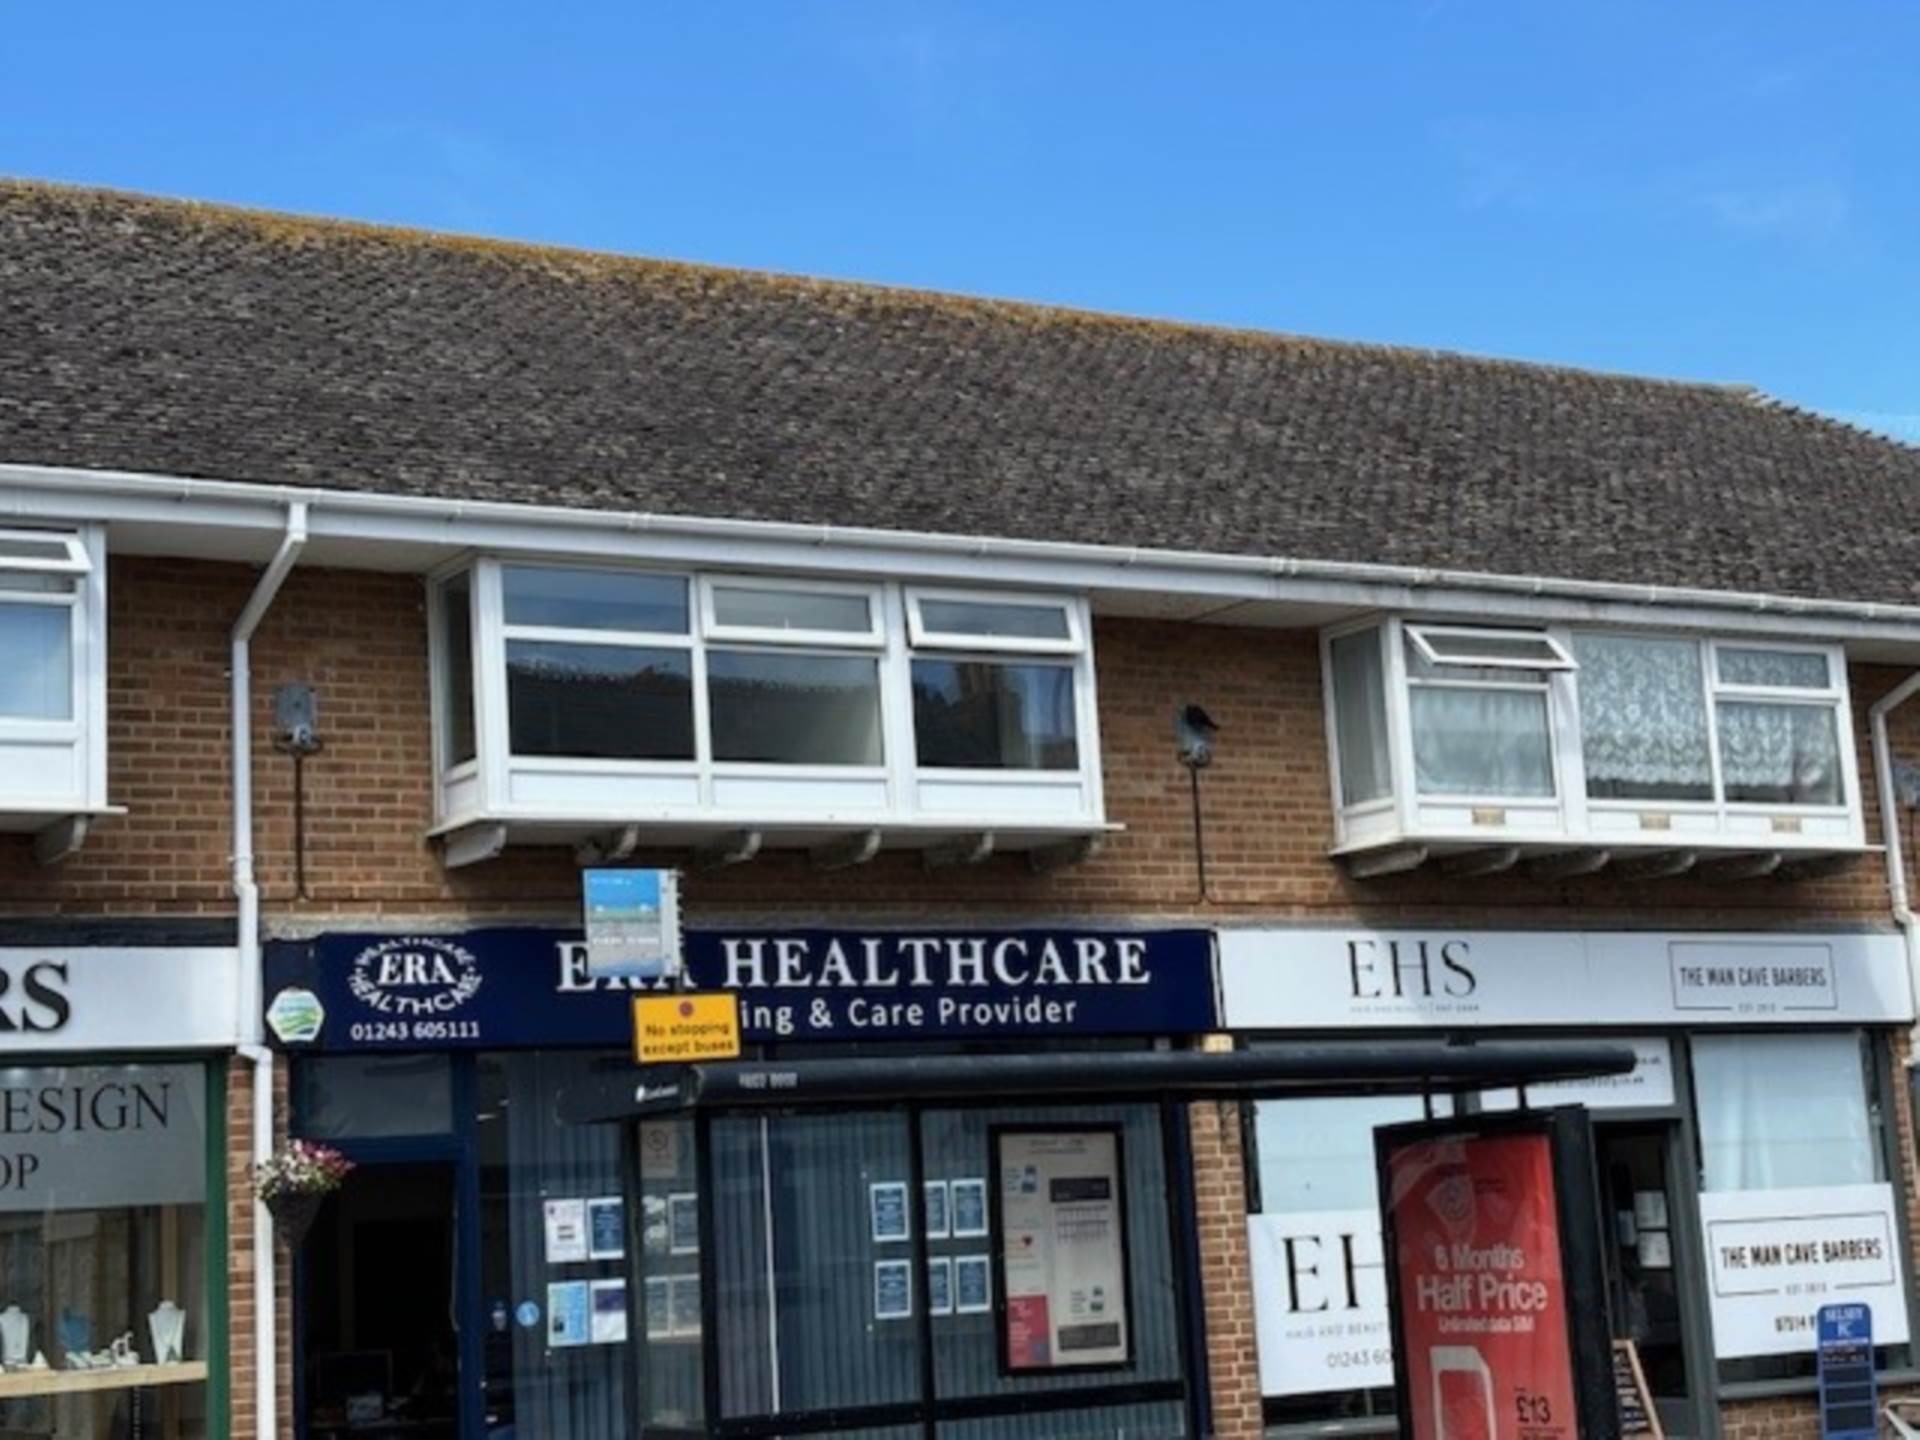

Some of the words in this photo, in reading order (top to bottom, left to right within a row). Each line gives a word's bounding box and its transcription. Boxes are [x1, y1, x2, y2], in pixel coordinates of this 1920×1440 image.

[377, 952, 456, 984] ERA
[722, 937, 1151, 988] HEALTHCARE
[1347, 940, 1477, 998] EHS
[1680, 967, 1704, 986] THE
[1706, 967, 1735, 986] MAN
[1738, 967, 1769, 987] CAVE
[1771, 967, 1826, 987] BARBERS
[0, 960, 71, 1033] S
[809, 999, 833, 1027] &
[850, 999, 924, 1026] Care
[938, 996, 1077, 1024] Provider
[351, 1024, 408, 1041] 01243
[413, 1021, 480, 1040] 605111
[645, 1025, 666, 1037] No
[670, 1024, 730, 1037] stopping
[643, 1042, 690, 1055] except
[694, 1040, 733, 1052] buses
[1451, 1244, 1525, 1270] Months
[1720, 1246, 1748, 1269] THE
[1750, 1244, 1782, 1266] MAN
[1784, 1241, 1819, 1264] CAVE
[1821, 1237, 1882, 1263] BARBERS
[1416, 1275, 1473, 1312] Half
[1478, 1272, 1548, 1311] Price
[1515, 1395, 1552, 1424] £13
